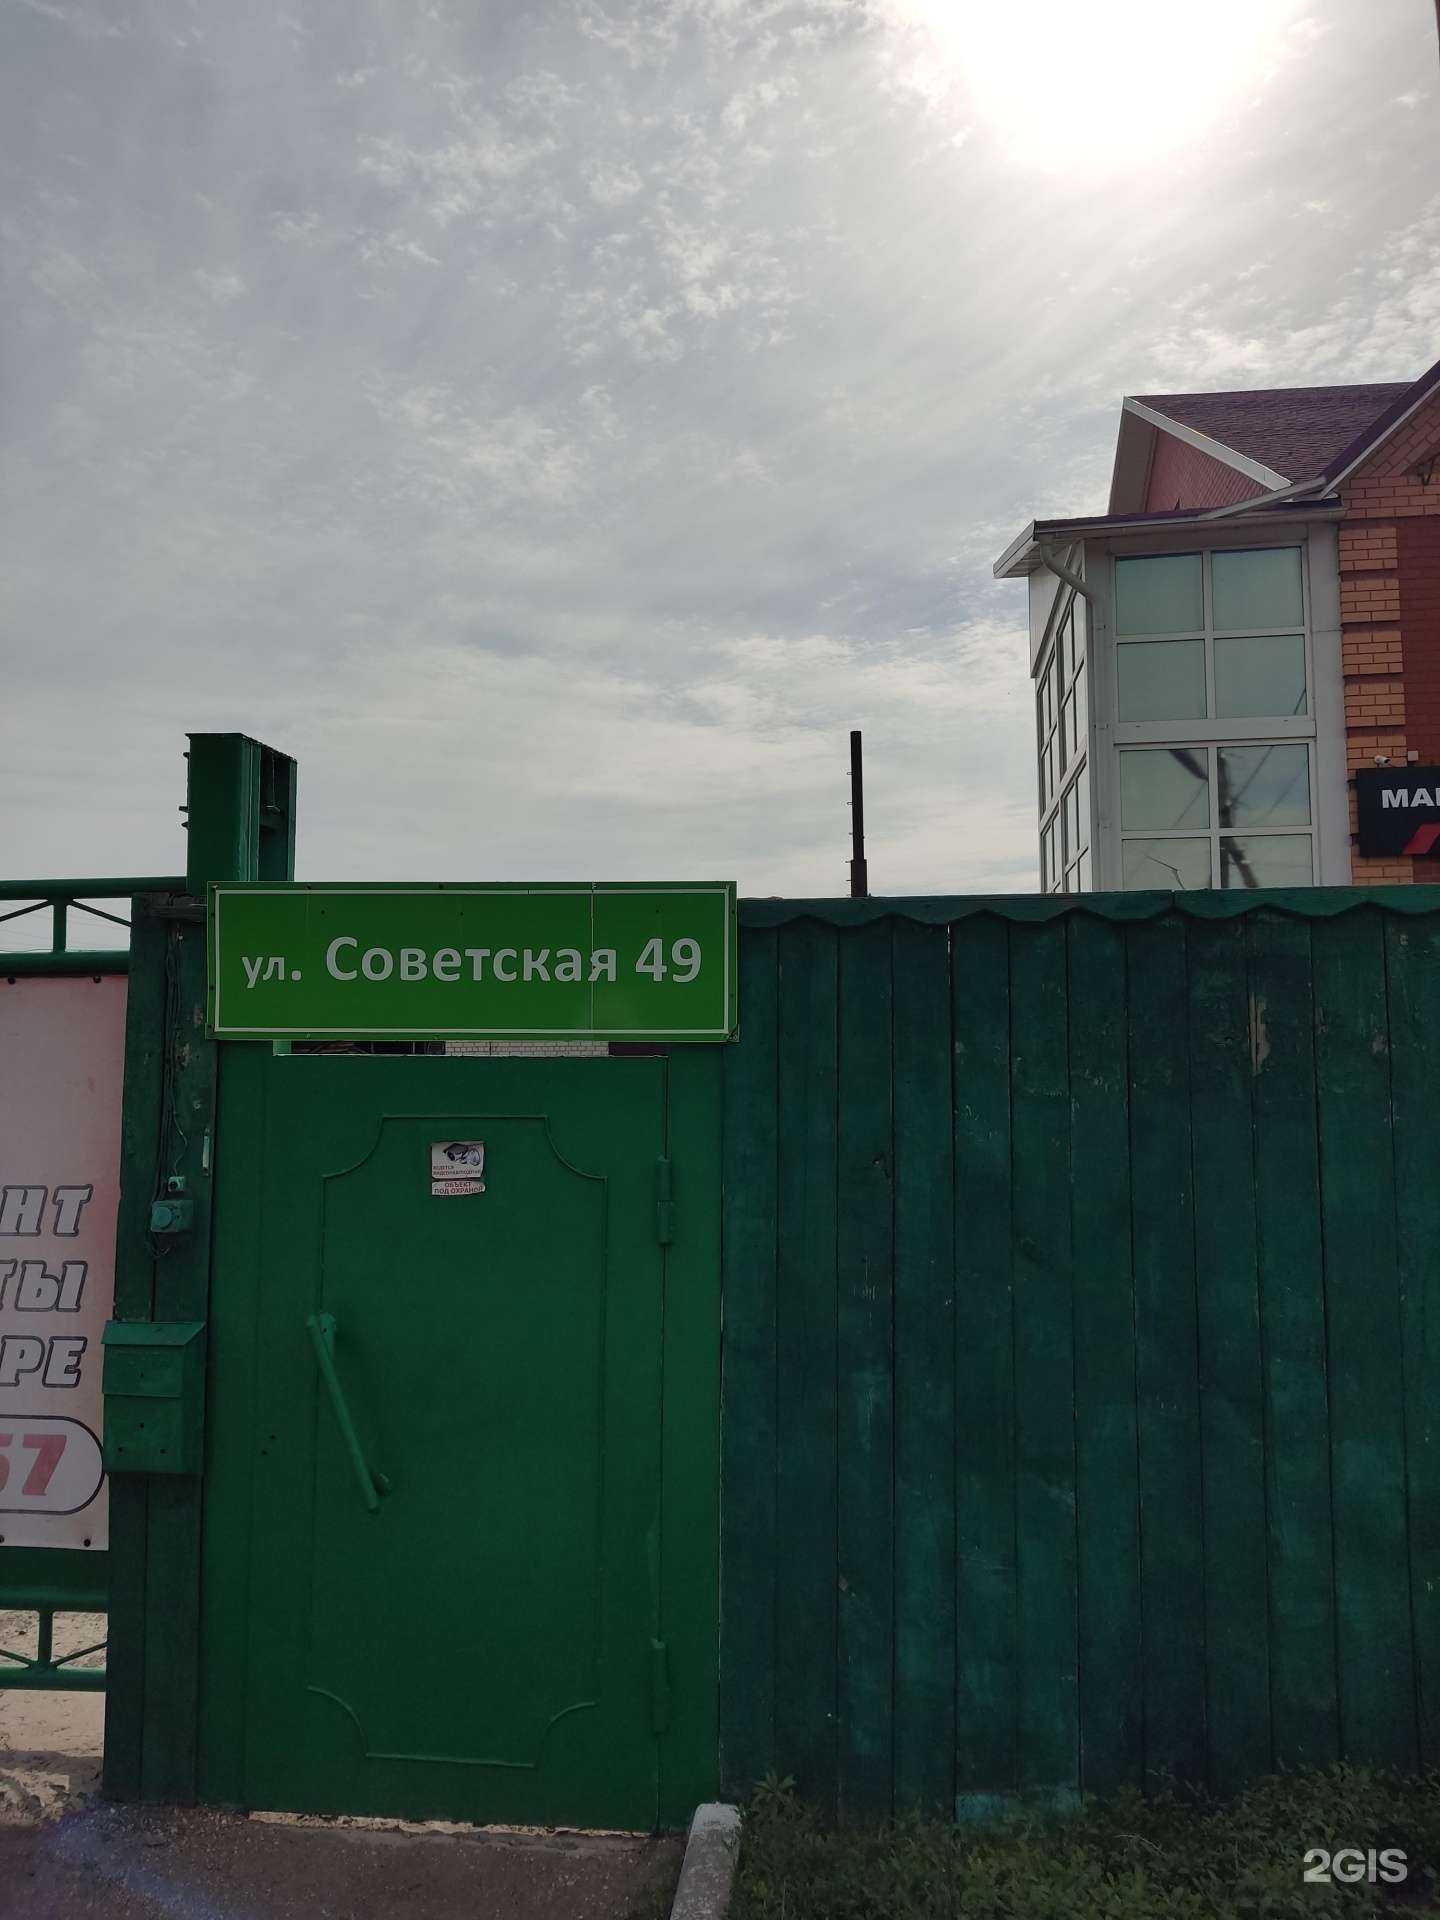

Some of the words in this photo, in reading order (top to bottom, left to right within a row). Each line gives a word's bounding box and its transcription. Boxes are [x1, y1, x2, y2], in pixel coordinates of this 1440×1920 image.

[1381, 787, 1440, 809] МА
[241, 956, 302, 989] ул.
[326, 936, 617, 982] Советская
[635, 937, 702, 983] 49
